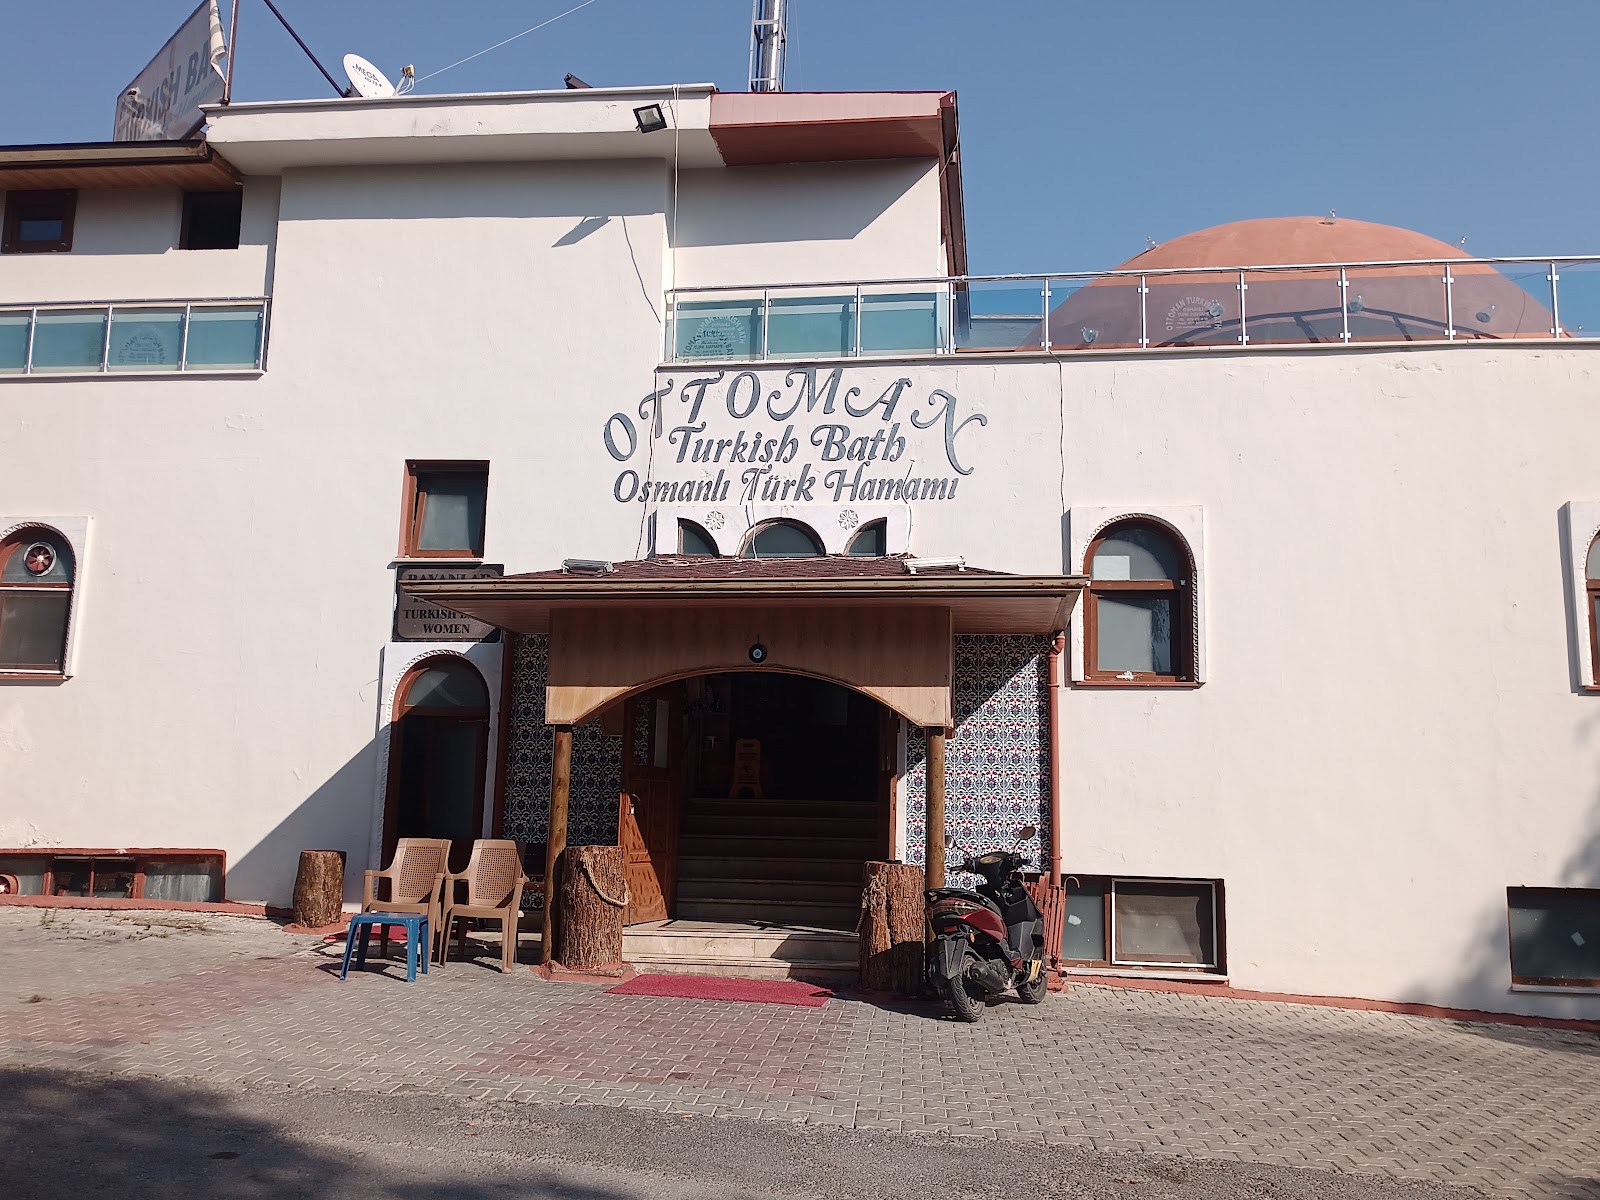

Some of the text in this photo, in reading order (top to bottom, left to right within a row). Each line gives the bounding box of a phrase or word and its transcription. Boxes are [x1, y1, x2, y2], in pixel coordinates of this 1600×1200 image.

[1165, 299, 1185, 331] OTTOMAN
[603, 367, 988, 476] OTTOMAN
[668, 421, 906, 464] Turkish Bath
[613, 461, 959, 503] Osmanlı Türk Hamamı
[404, 609, 456, 619] TURKISH
[423, 623, 471, 634] WOMEN
